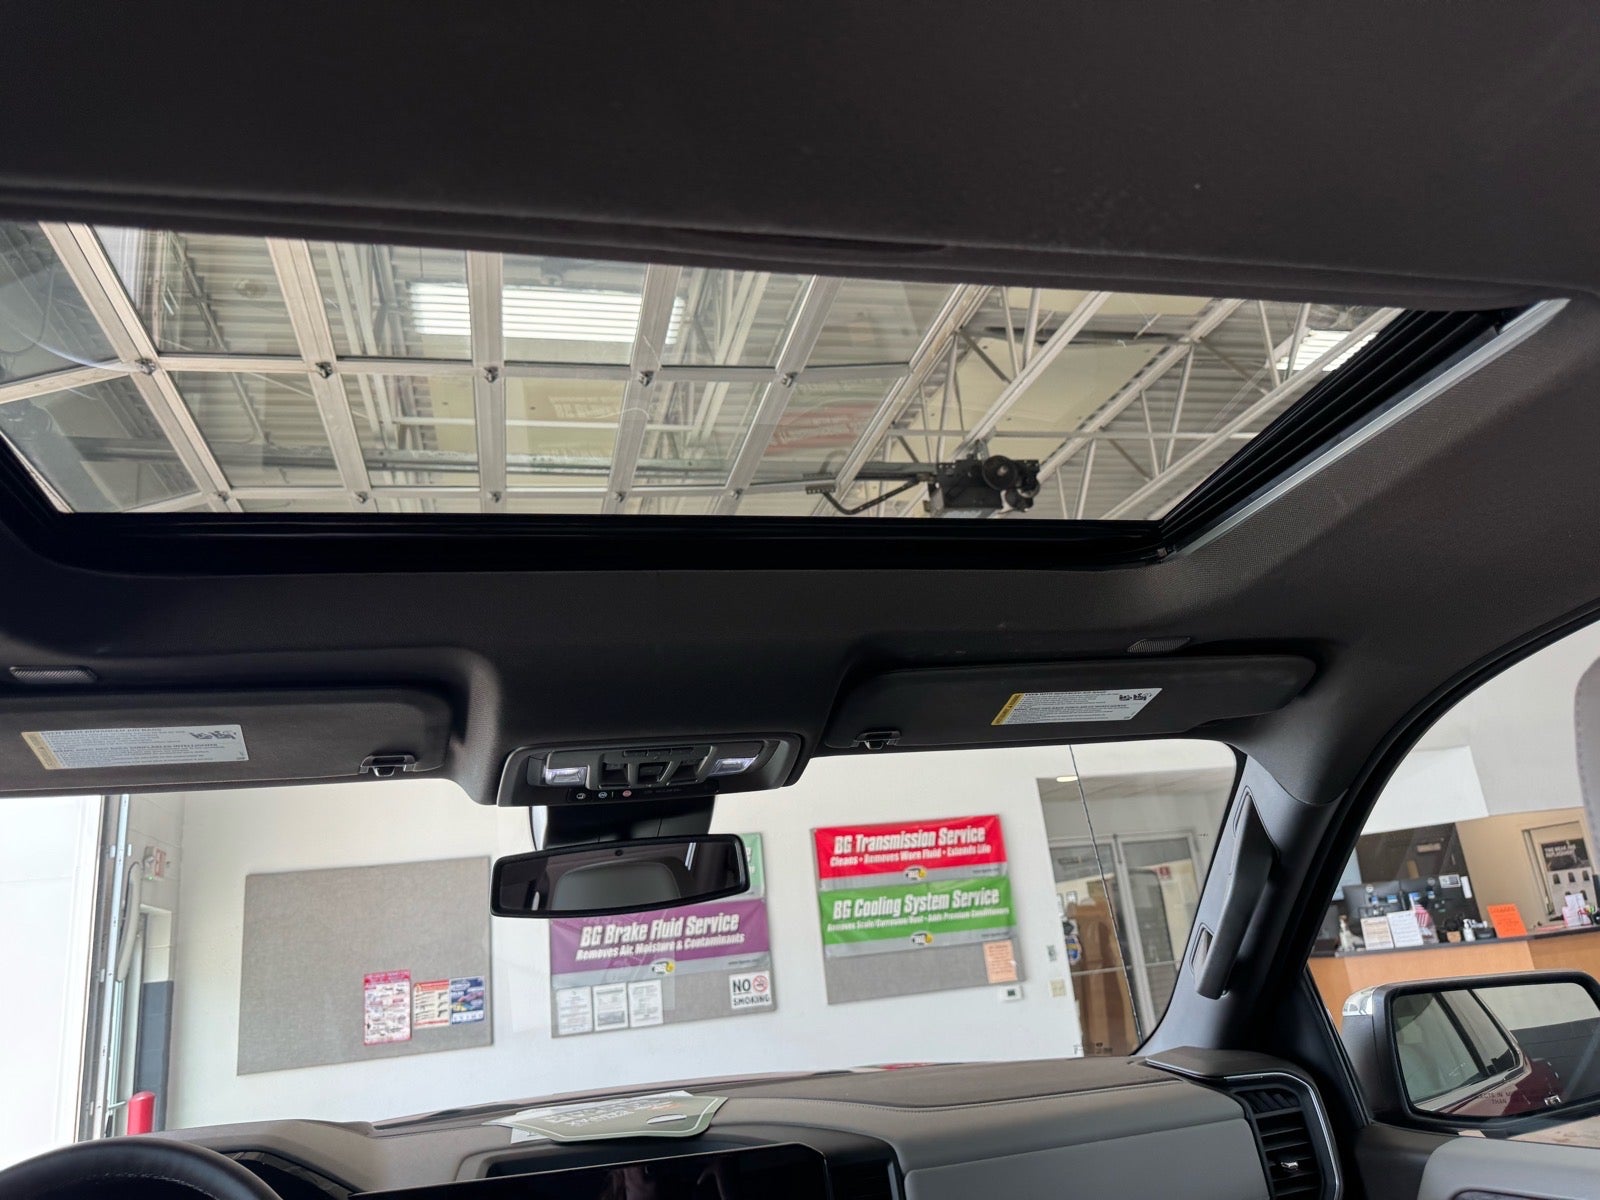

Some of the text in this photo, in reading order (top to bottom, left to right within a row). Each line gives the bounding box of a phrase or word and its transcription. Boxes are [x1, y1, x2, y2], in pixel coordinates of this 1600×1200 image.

[834, 826, 985, 855] BG Transmission Service
[833, 887, 1000, 920] BG Cooling System Service
[580, 913, 739, 947] BG Brake Fluid Service
[575, 946, 618, 960] Removes
[636, 940, 675, 954] Moisture
[676, 941, 683, 950] &
[684, 933, 745, 949] Contaminants
[733, 979, 751, 992] NO
[733, 994, 770, 1006] SMOKING
